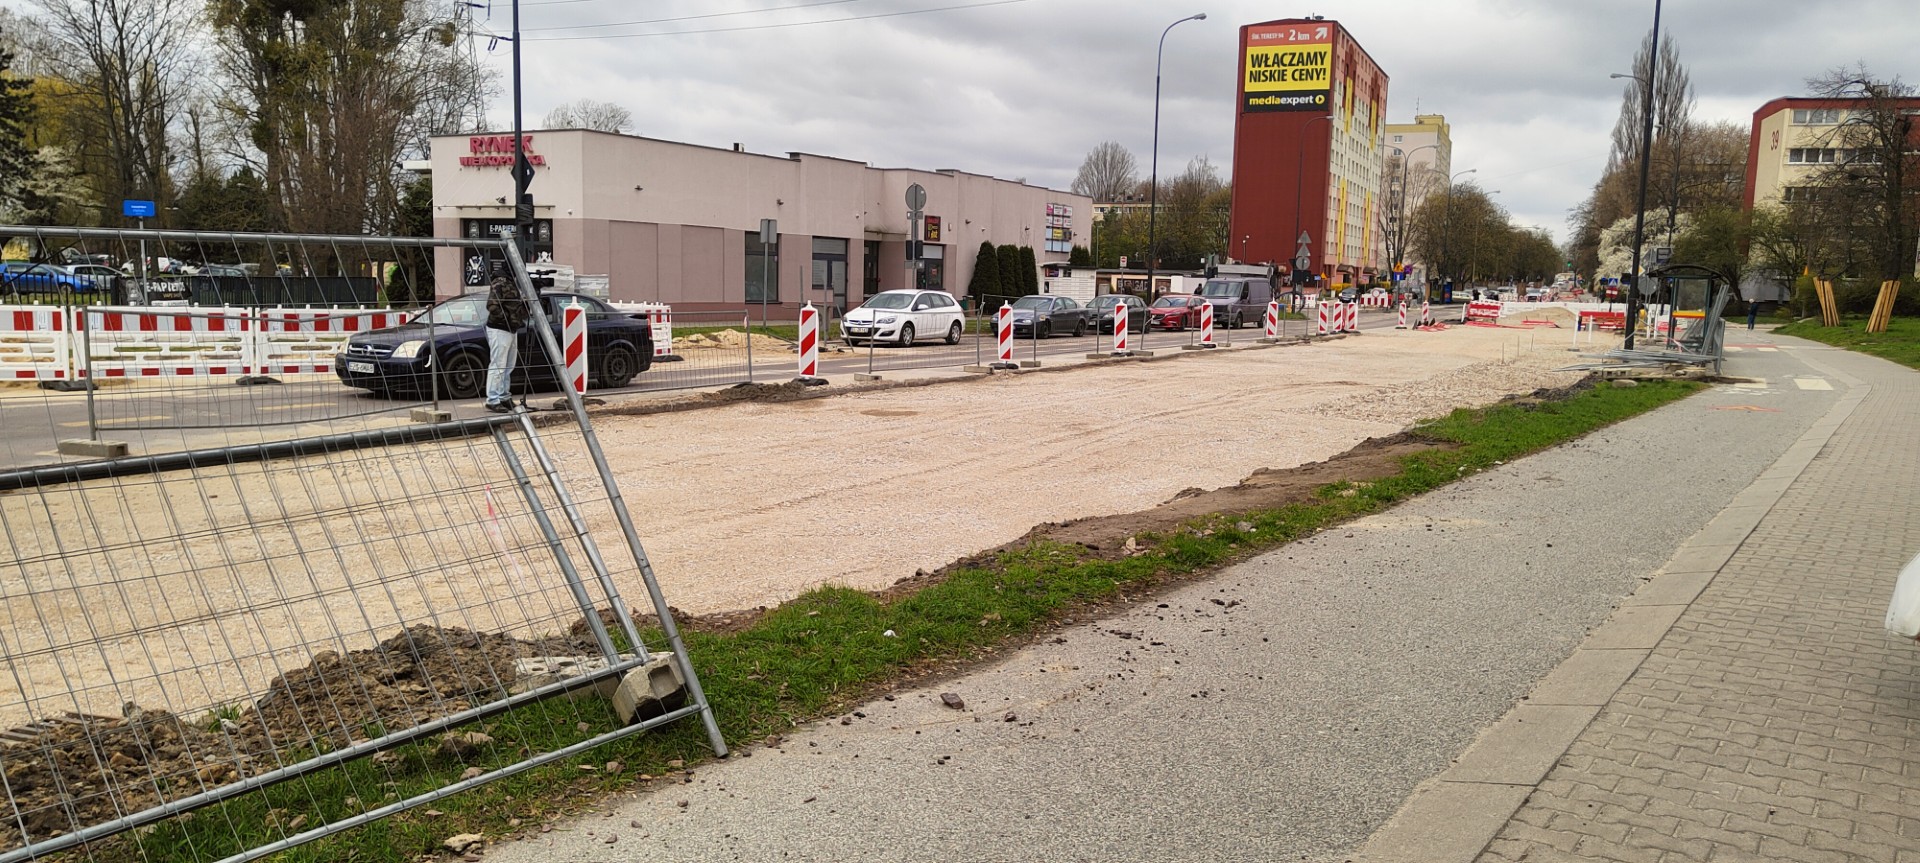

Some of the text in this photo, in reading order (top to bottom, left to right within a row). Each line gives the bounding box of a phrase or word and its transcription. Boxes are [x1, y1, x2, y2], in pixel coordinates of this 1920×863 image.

[1288, 29, 1296, 41] 2
[1298, 32, 1309, 40] km
[1251, 51, 1327, 68] WŁĄCZAMY
[1249, 68, 1327, 82] NISKIE CENY!
[1249, 94, 1314, 106] mediaexpert
[469, 135, 534, 153] RYNEK
[1770, 129, 1780, 151] 39
